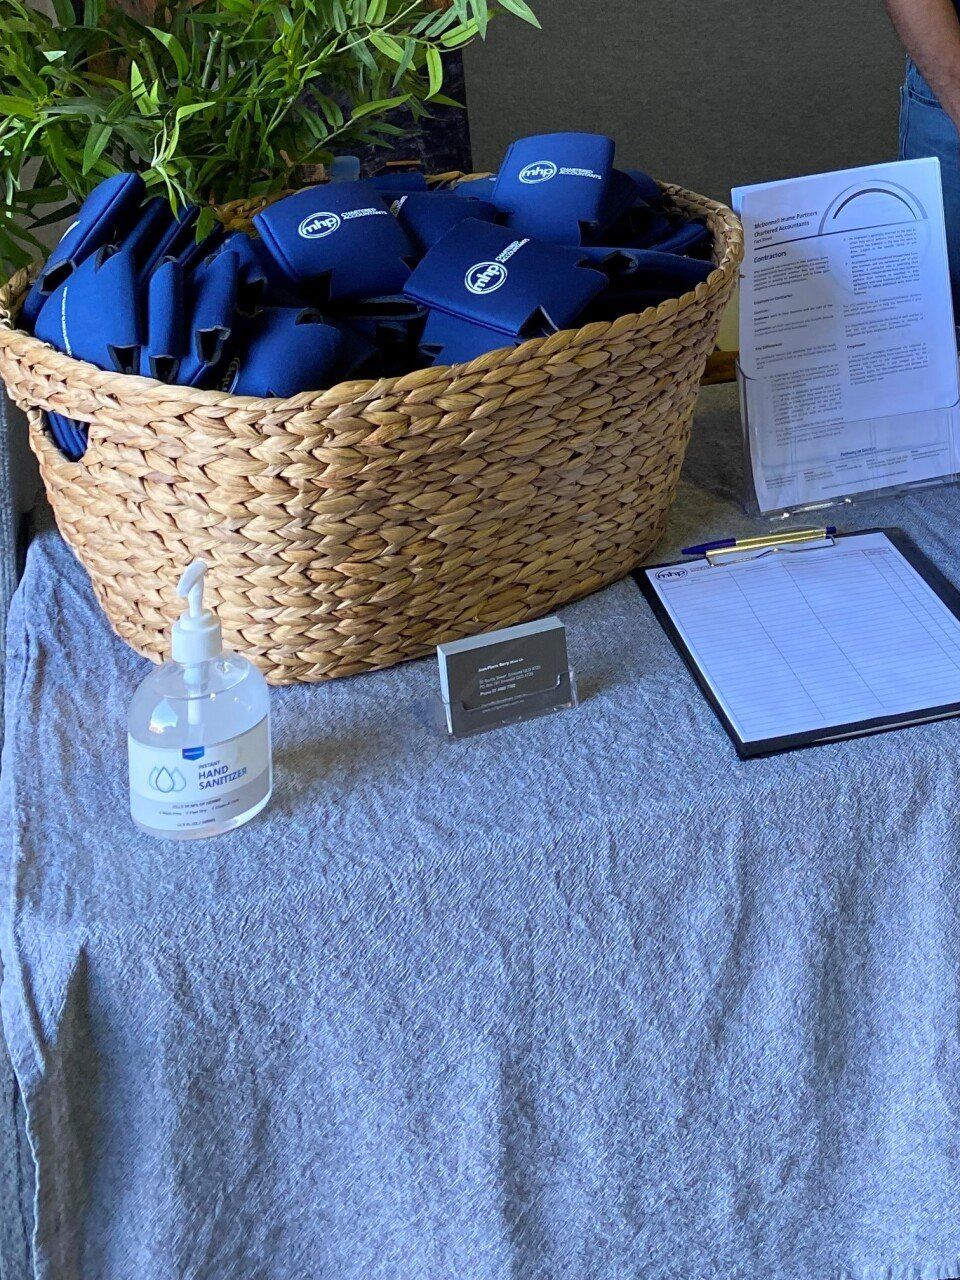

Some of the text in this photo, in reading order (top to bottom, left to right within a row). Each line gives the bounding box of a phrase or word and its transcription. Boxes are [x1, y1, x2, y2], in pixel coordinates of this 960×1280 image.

[521, 166, 553, 179] mhp
[301, 217, 335, 236] mhp
[754, 210, 818, 229] McDonnell Hume Partners
[753, 220, 810, 238] Chartered Accountants
[753, 250, 787, 263] Contractors
[473, 265, 501, 292] mhp
[657, 570, 686, 580] mhp
[198, 765, 229, 780] HAND
[199, 766, 247, 790] SANITIZER
